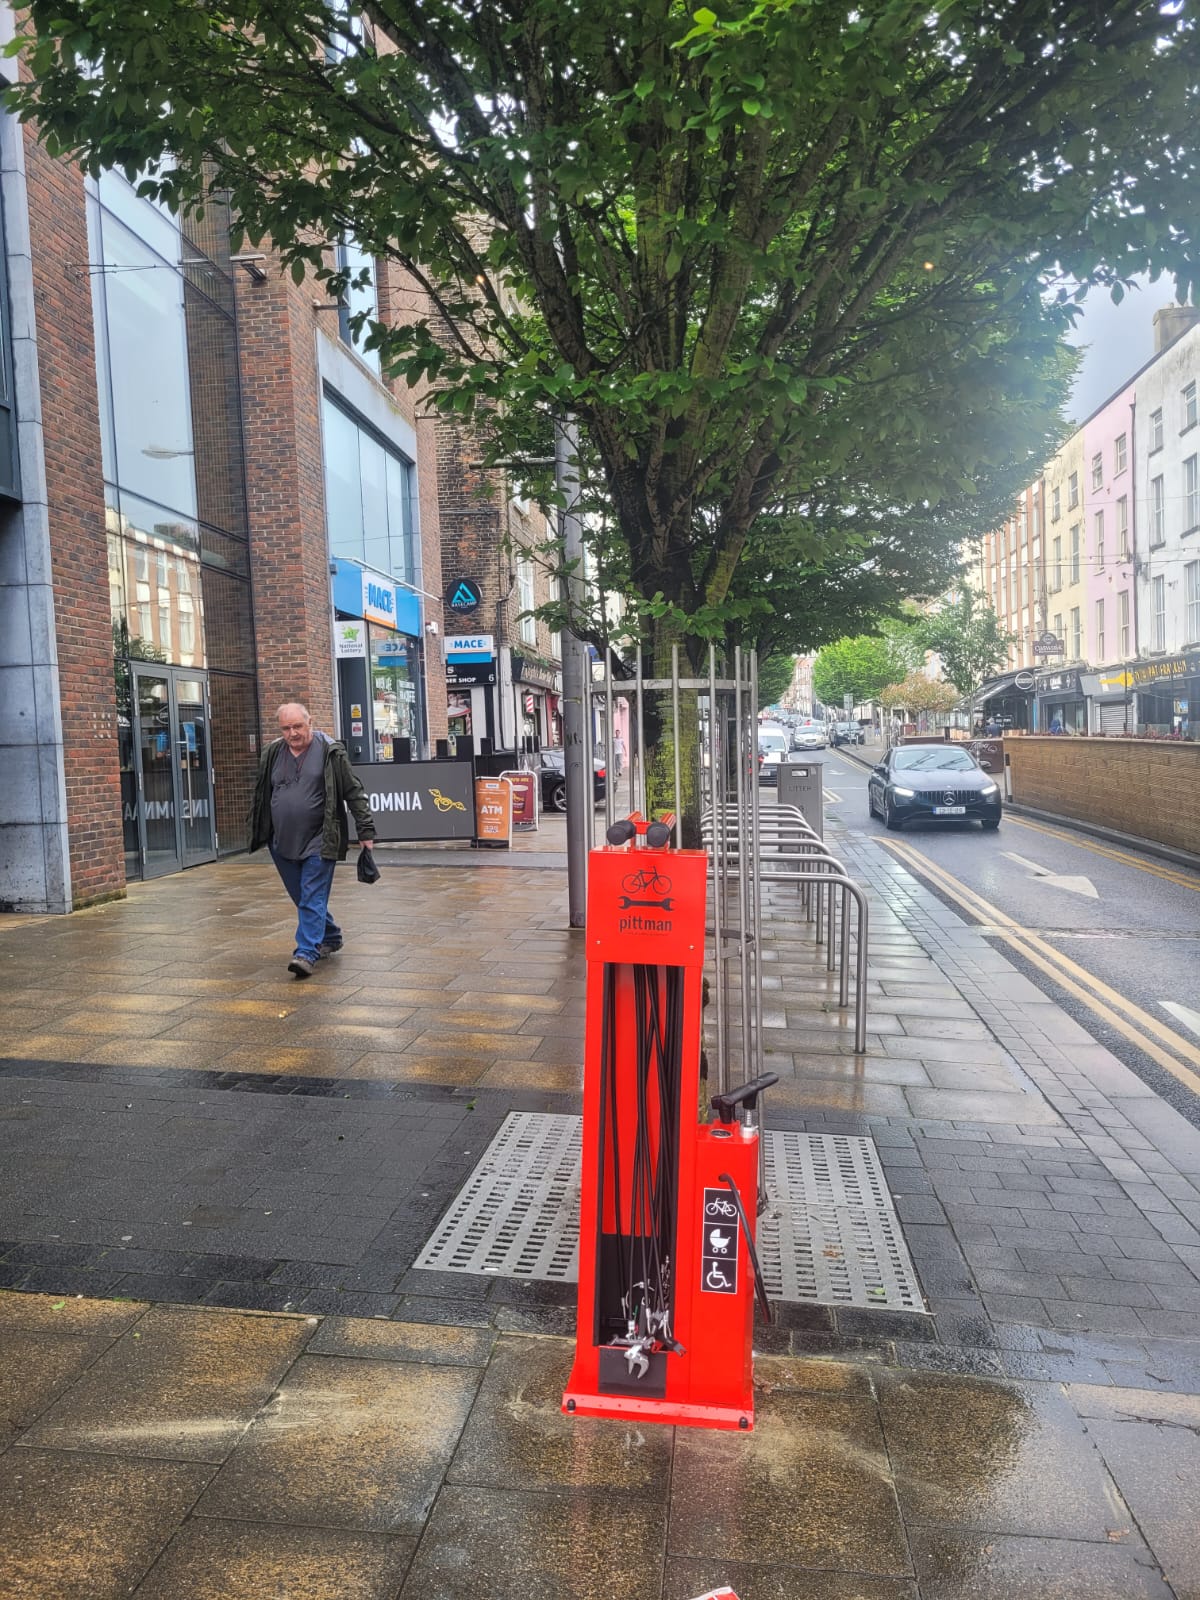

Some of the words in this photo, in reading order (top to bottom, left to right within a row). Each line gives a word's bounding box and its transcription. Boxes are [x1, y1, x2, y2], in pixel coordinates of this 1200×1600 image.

[368, 582, 393, 614] MACE
[454, 640, 484, 649] MACE
[488, 673, 495, 682] 6
[480, 804, 503, 815] ATM
[619, 916, 673, 933] pittman
